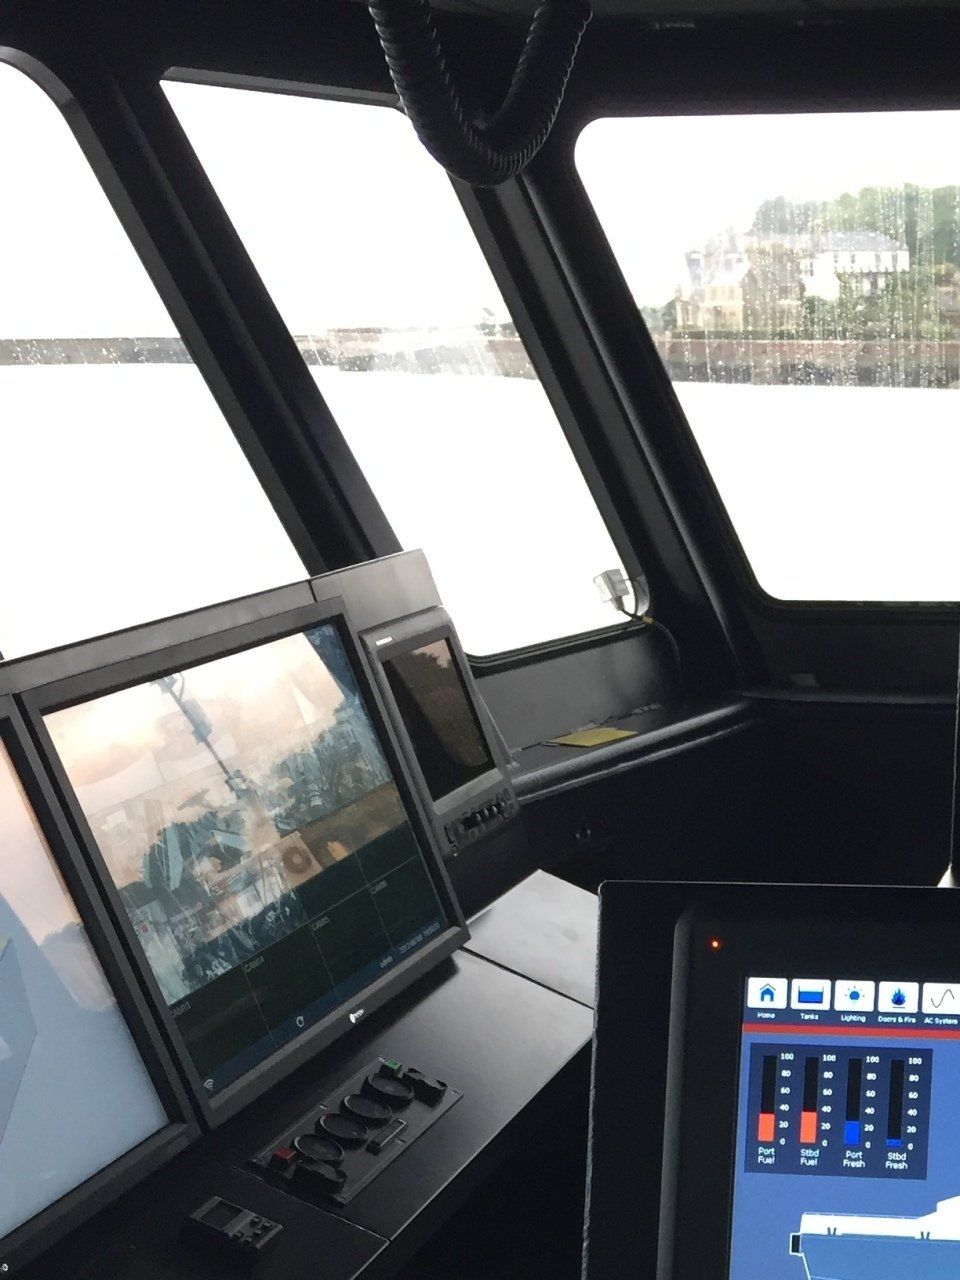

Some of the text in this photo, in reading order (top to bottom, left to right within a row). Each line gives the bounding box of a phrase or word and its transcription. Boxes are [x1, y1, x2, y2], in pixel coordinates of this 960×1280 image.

[841, 1014, 866, 1022] Lighting
[822, 1054, 836, 1062] 100
[909, 1074, 919, 1082] 80
[822, 1088, 832, 1096] 60
[866, 1090, 876, 1098] 60
[780, 1104, 789, 1112] 40
[908, 1108, 917, 1116] 40
[821, 1122, 830, 1130] 20
[864, 1124, 874, 1132] 20
[906, 1126, 916, 1134] 20
[758, 1148, 775, 1156] Port
[800, 1148, 819, 1157] Stbd
[846, 1150, 862, 1158] Port
[888, 1152, 906, 1160] Stbd
[758, 1156, 775, 1164] Fuel
[800, 1157, 818, 1166] Fuel
[843, 1159, 866, 1168] Fresh
[886, 1160, 908, 1170] Fresh
